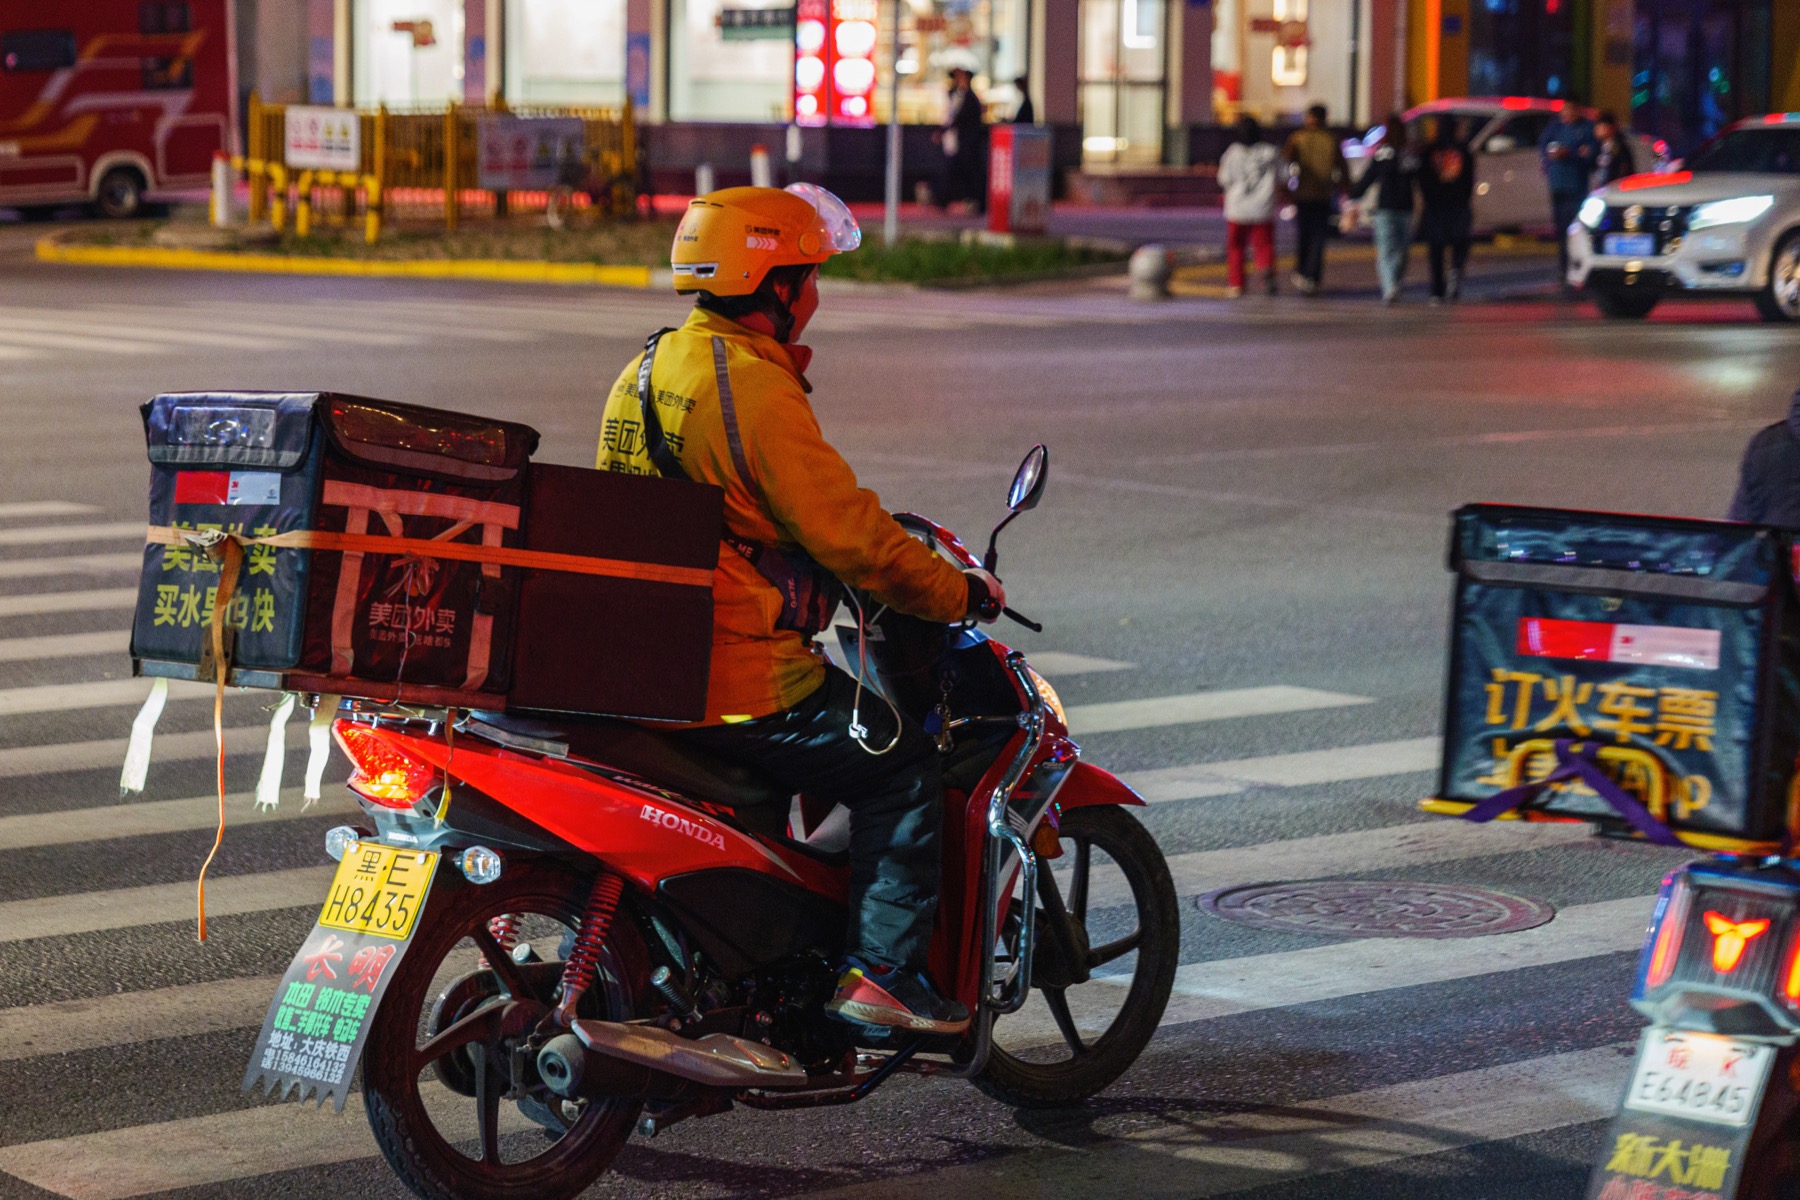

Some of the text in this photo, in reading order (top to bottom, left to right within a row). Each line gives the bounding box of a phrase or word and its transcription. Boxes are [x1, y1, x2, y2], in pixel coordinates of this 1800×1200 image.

[656, 389, 697, 414] 美团外卖
[162, 520, 277, 576] 美卖
[368, 601, 456, 634] 美团外卖
[1485, 668, 1719, 751] 订火车票
[640, 804, 726, 851] HONDA
[326, 884, 415, 931] H8435
[282, 981, 316, 1008] 本田
